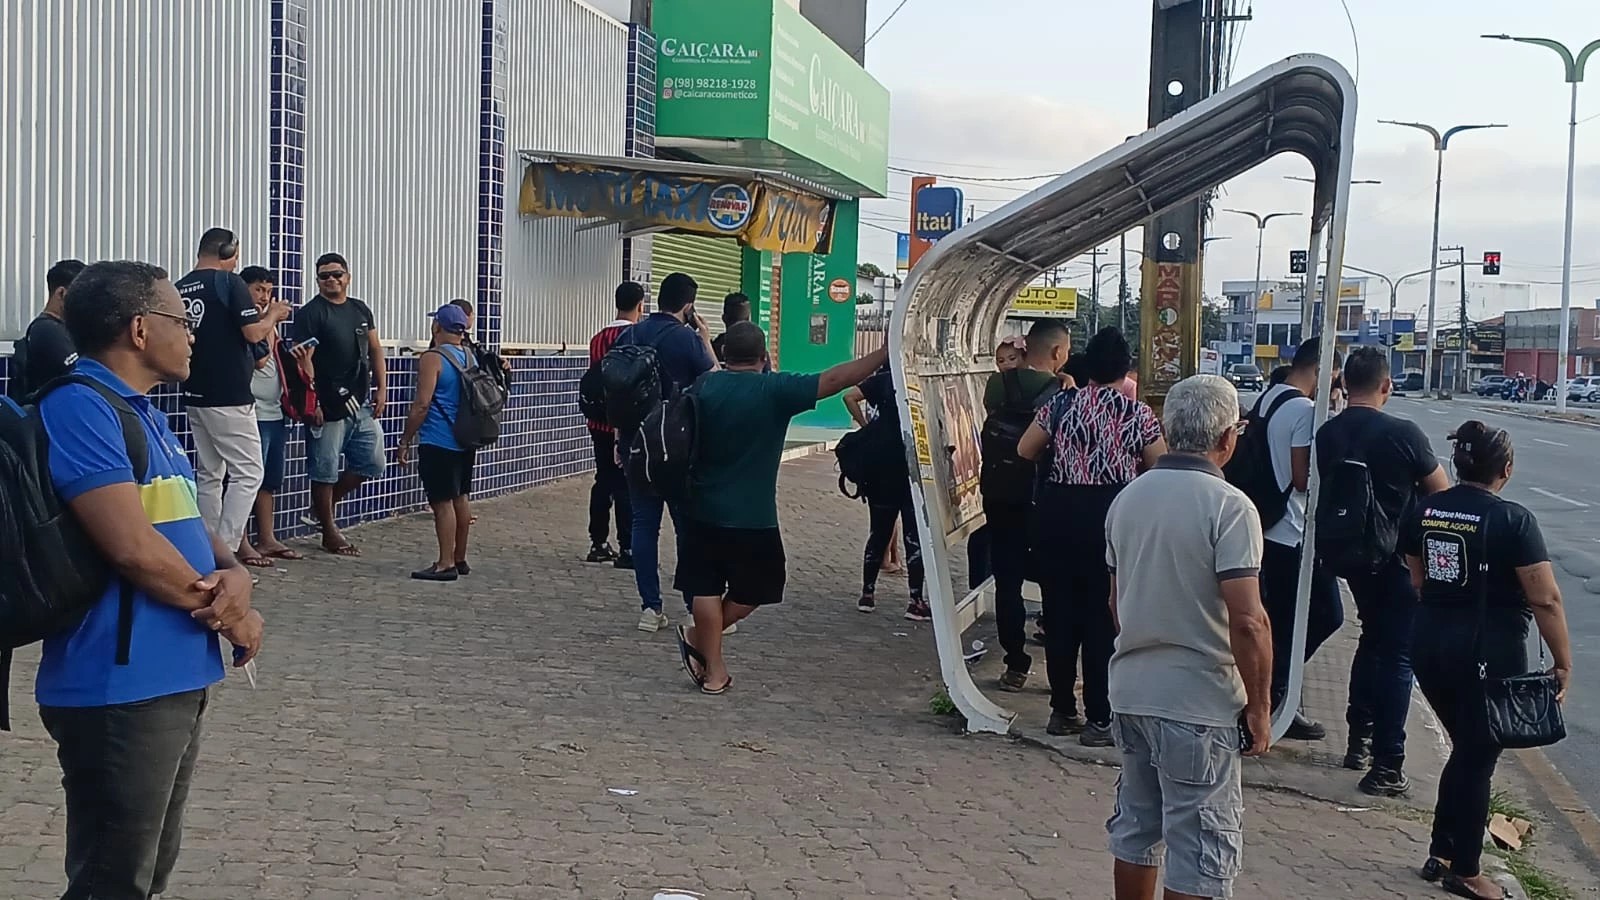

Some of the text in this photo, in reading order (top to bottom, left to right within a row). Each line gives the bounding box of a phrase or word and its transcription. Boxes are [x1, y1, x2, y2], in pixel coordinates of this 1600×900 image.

[661, 38, 746, 58] CAIÇARA
[674, 77, 756, 90] (98) 98218-1928
[674, 89, 758, 100] @caicaracosmeticos
[809, 52, 859, 141] CAIÇARA
[917, 211, 952, 231] Itaú
[1421, 519, 1477, 533] COMPRE AGORA!
